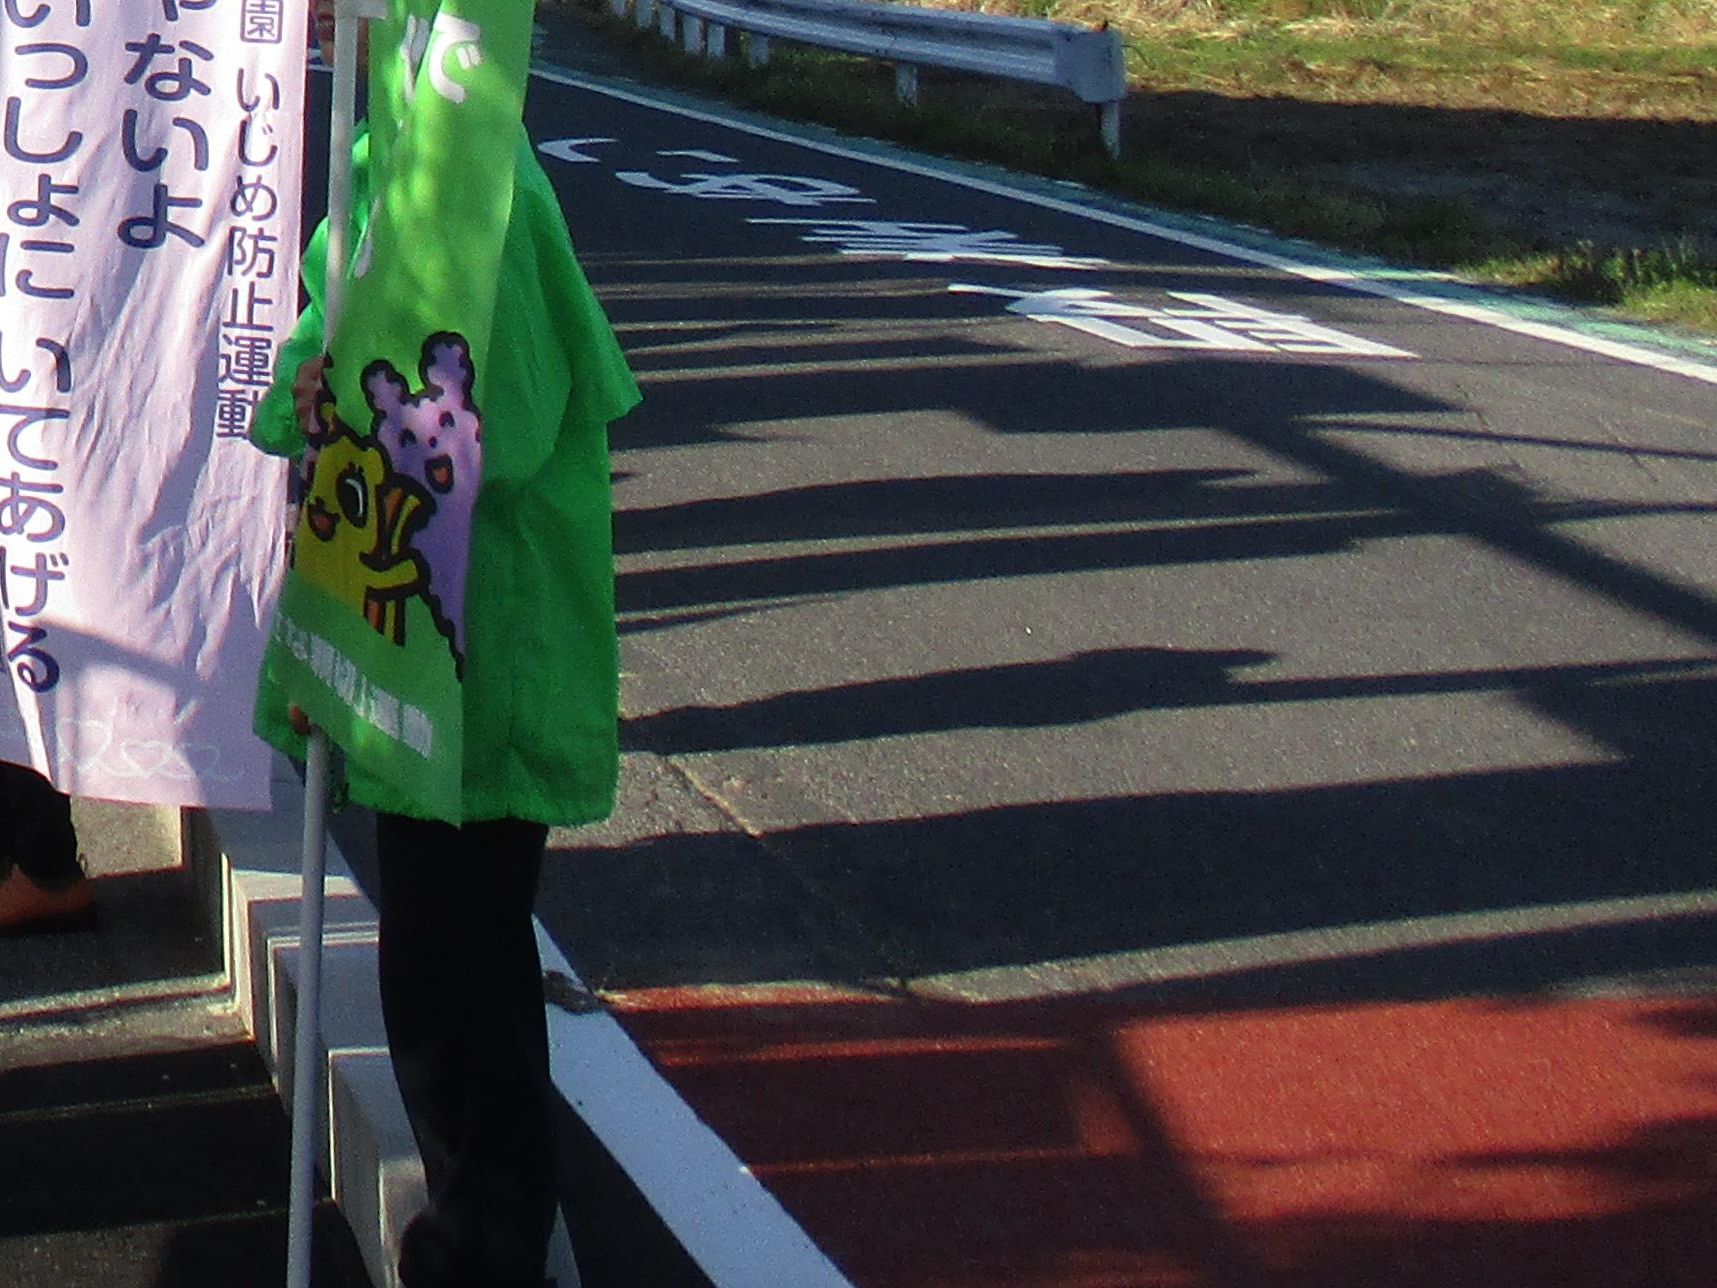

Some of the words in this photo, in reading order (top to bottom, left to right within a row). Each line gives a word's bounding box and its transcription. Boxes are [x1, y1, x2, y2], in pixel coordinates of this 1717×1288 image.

[215, 72, 284, 442] いじめ防止運動
